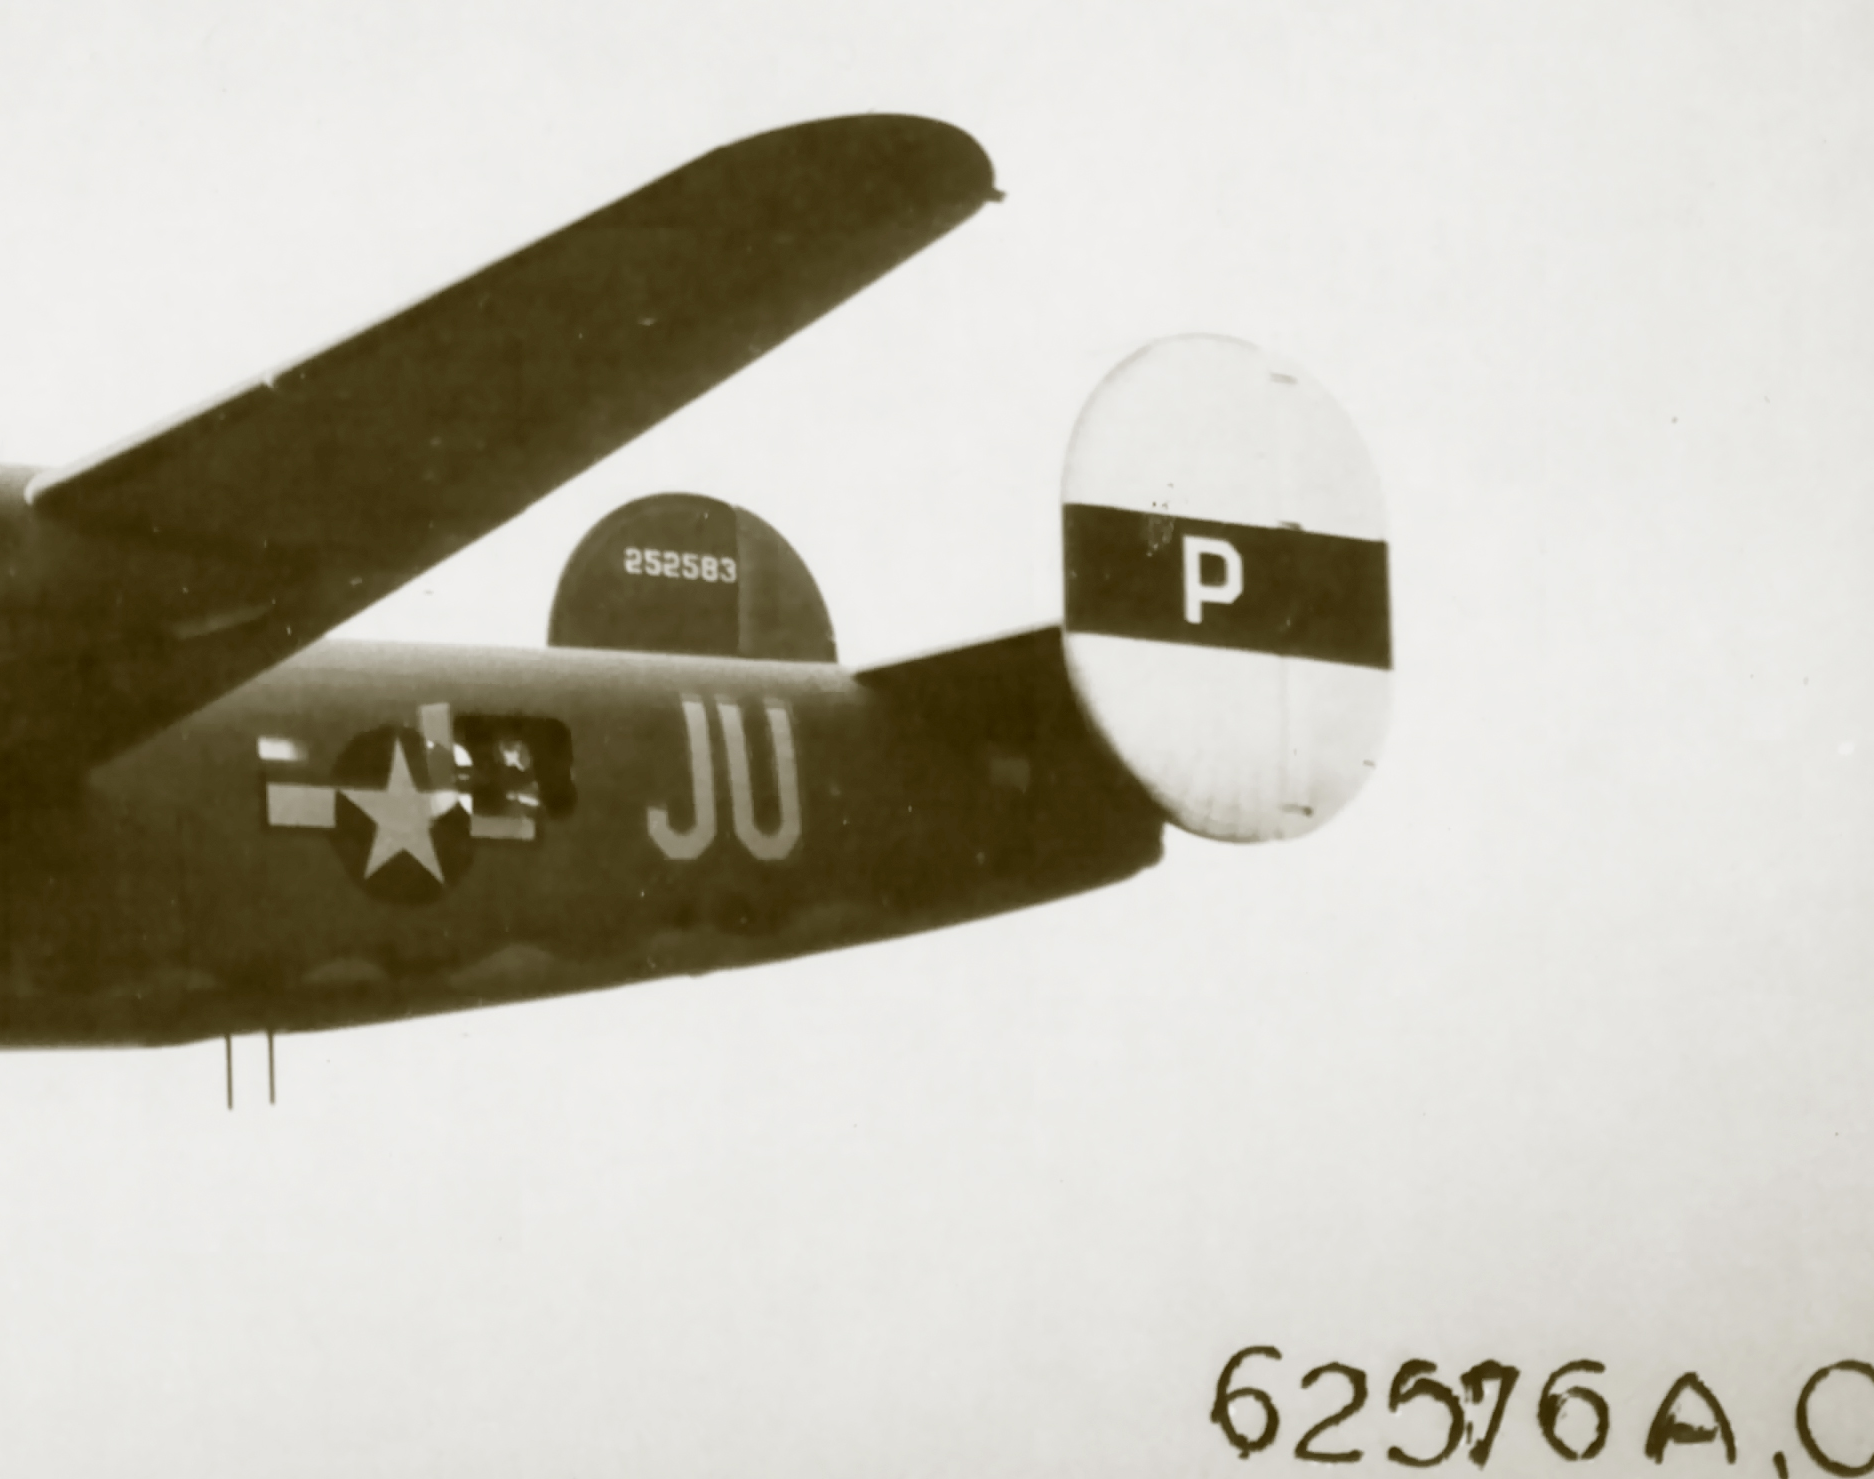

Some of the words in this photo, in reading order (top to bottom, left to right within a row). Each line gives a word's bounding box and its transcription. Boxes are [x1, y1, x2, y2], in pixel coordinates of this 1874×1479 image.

[623, 546, 738, 584] 252583
[1182, 533, 1244, 625] P
[647, 694, 802, 861] JU
